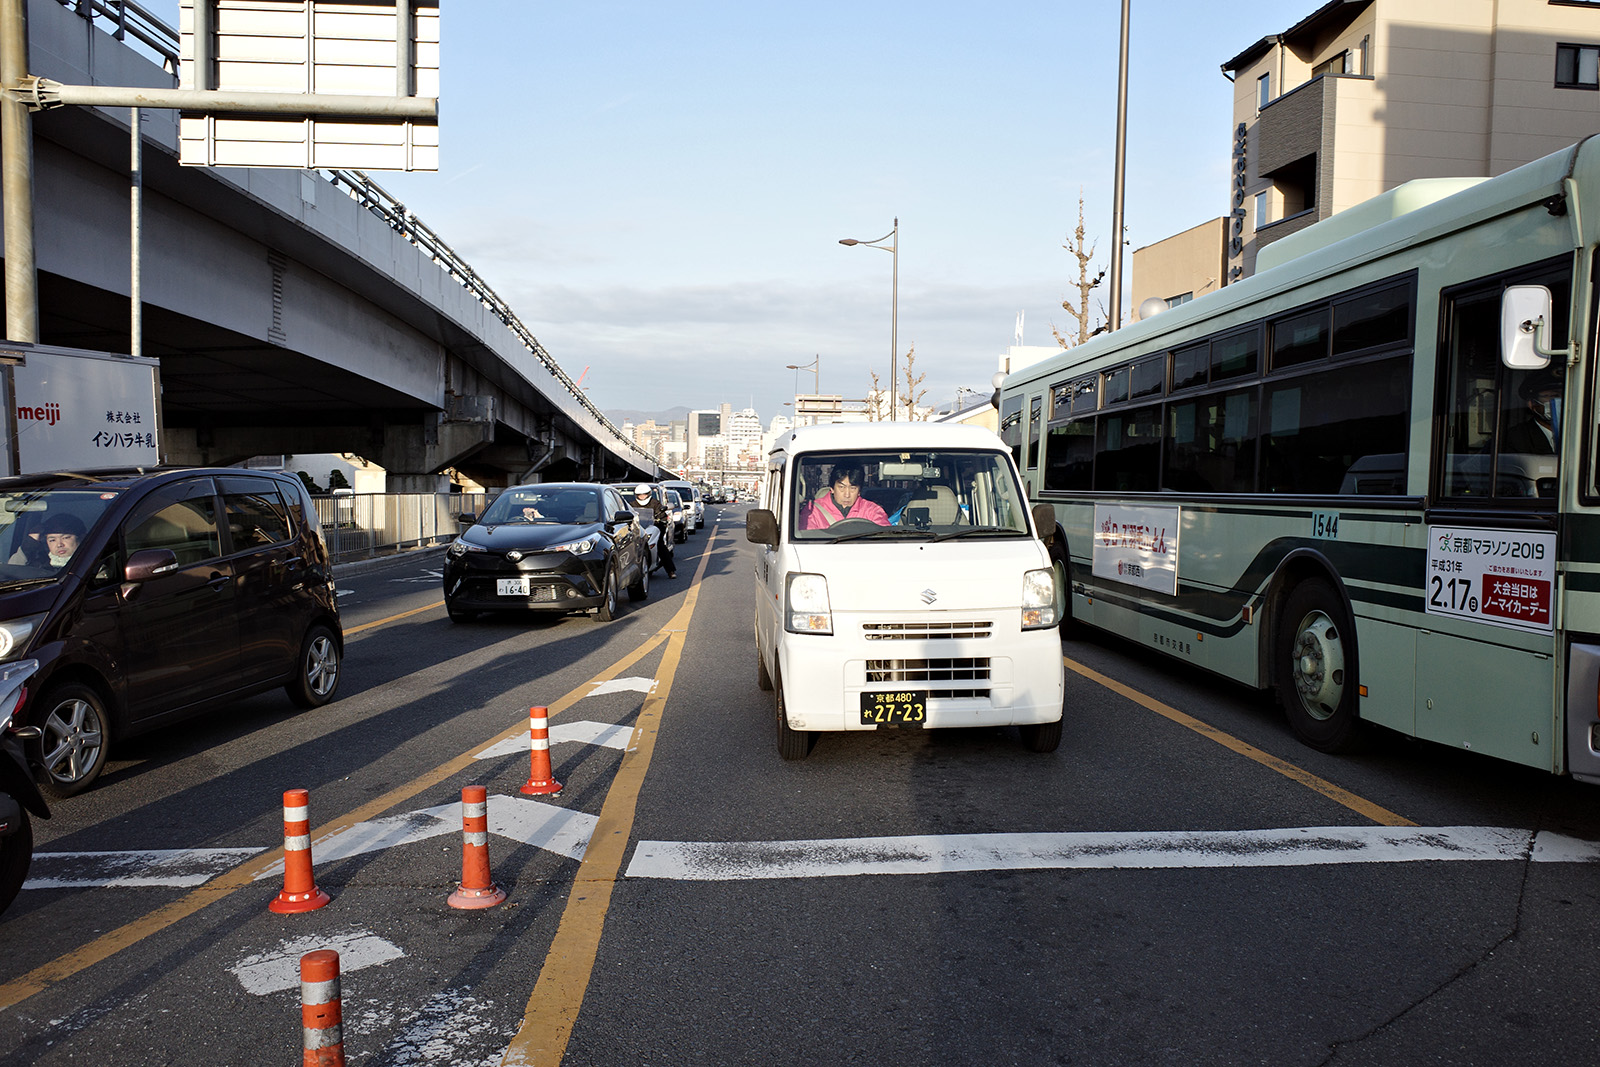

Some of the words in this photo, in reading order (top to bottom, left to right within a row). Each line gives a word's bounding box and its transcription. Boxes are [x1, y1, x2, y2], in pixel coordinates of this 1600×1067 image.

[1232, 122, 1247, 257] Gojozaka
[17, 402, 61, 426] meiji
[106, 410, 141, 424] 株式会社
[92, 431, 156, 448] イシハラ牛乳
[1312, 513, 1339, 538] 1544
[1431, 559, 1463, 573] 平成31年
[1493, 580, 1538, 599] 大会当日は
[1483, 596, 1548, 617] ノーマイカーデー
[874, 703, 924, 722] 27-23
